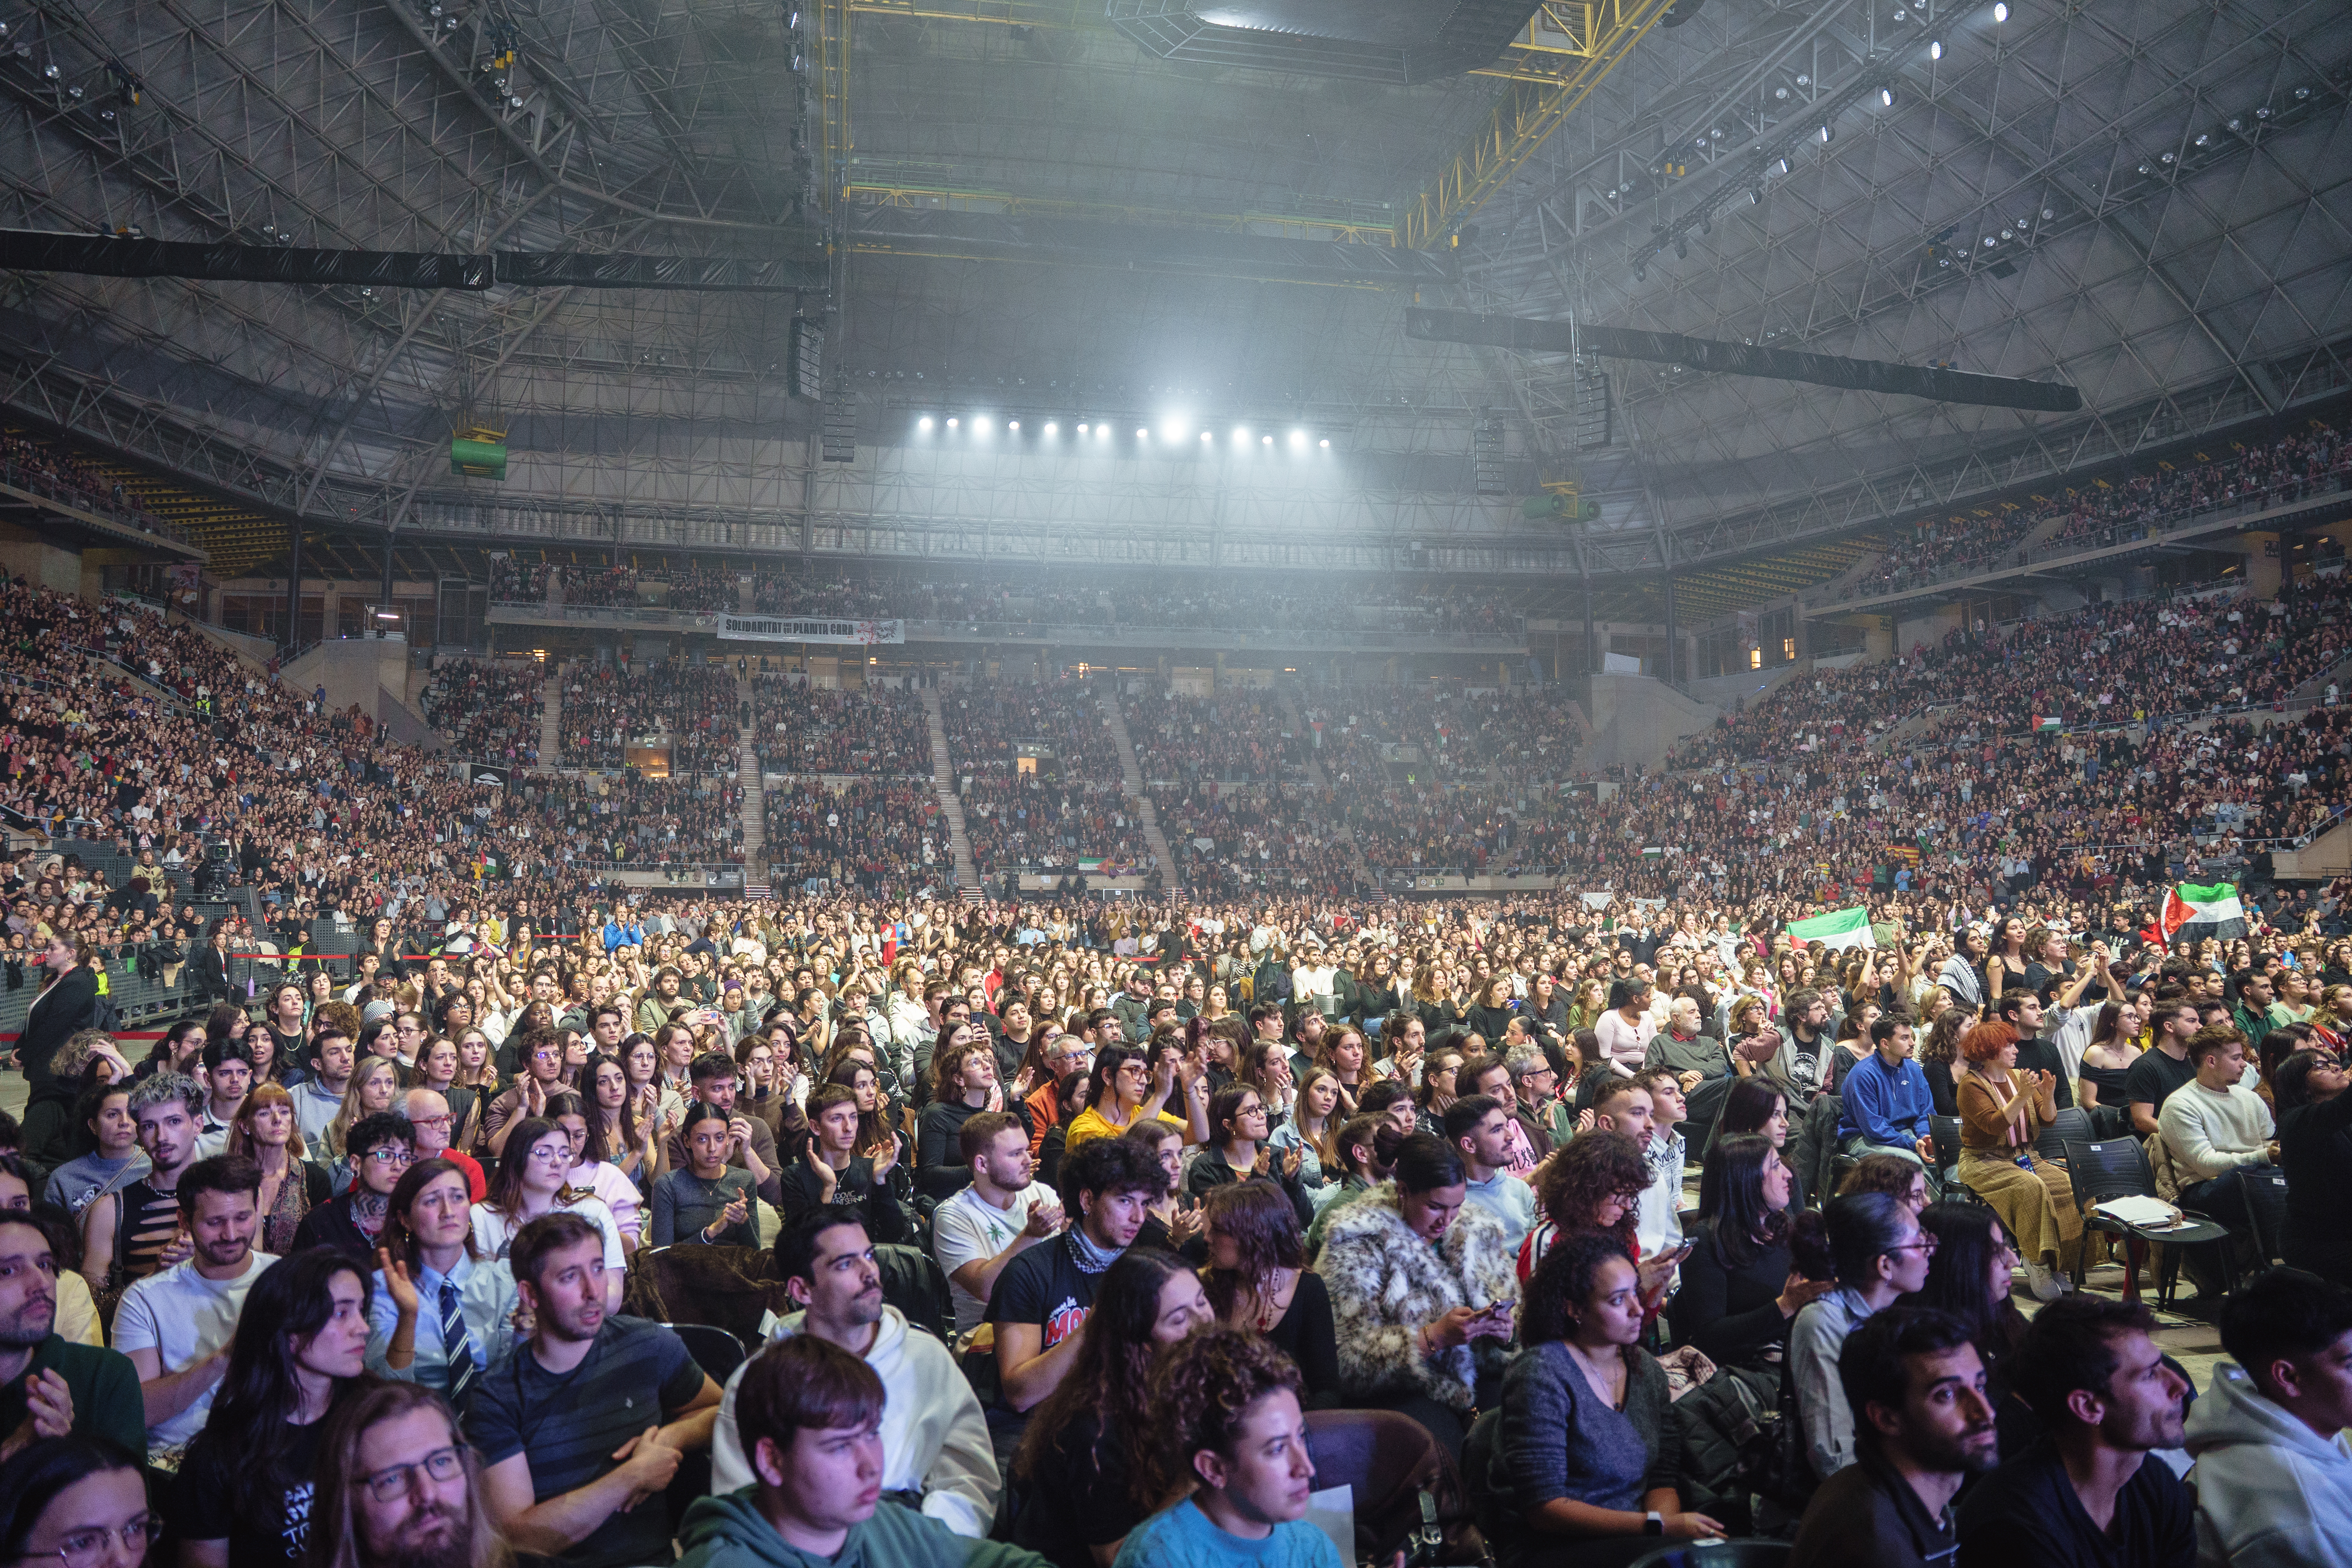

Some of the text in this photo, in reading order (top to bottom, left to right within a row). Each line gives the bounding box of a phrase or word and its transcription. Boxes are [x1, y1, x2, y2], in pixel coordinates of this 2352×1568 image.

[726, 619, 782, 633] SOLIDARITAT
[793, 623, 829, 635] PLANTA
[830, 623, 853, 635] CARA
[1045, 1306, 1090, 1346] MO
